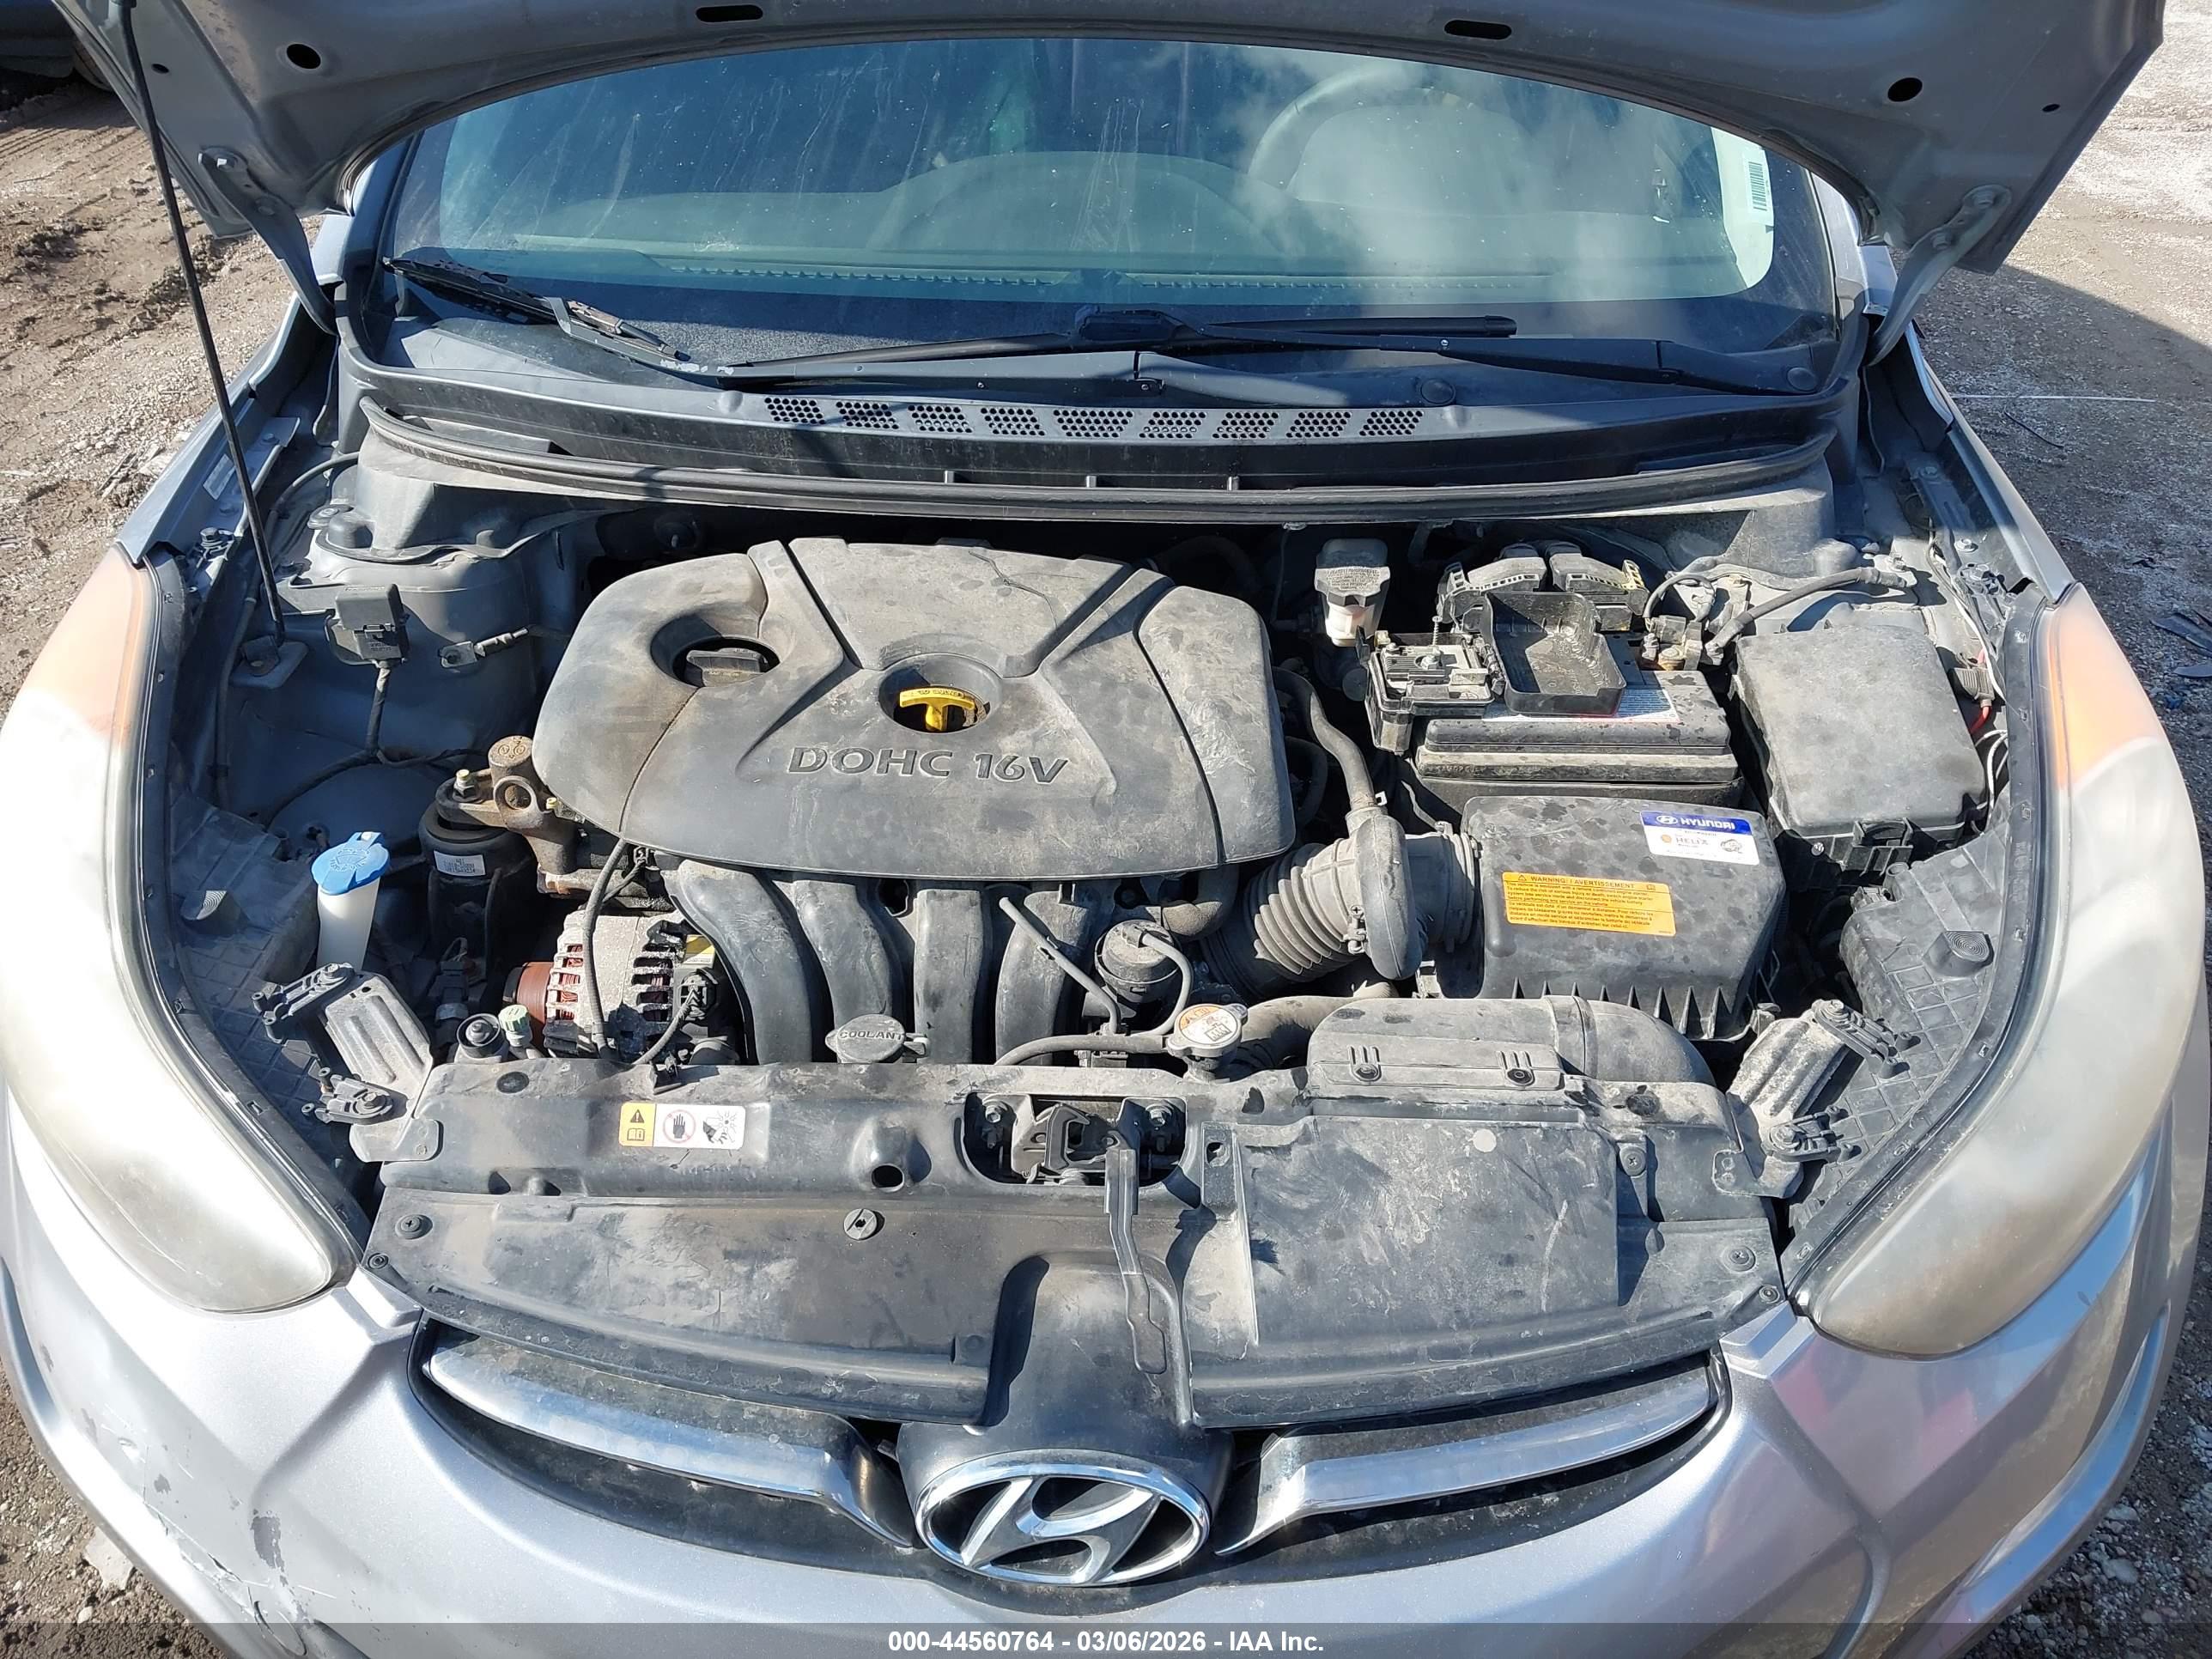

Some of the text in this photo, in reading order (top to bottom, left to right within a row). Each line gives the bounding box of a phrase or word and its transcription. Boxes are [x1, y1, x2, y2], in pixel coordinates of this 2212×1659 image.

[787, 746, 1069, 785] DOHC 16V
[1680, 817, 1736, 830] HYUNDAI
[1574, 878, 1635, 888] AVERTISSEMENT
[840, 1030, 903, 1041] COOLANT
